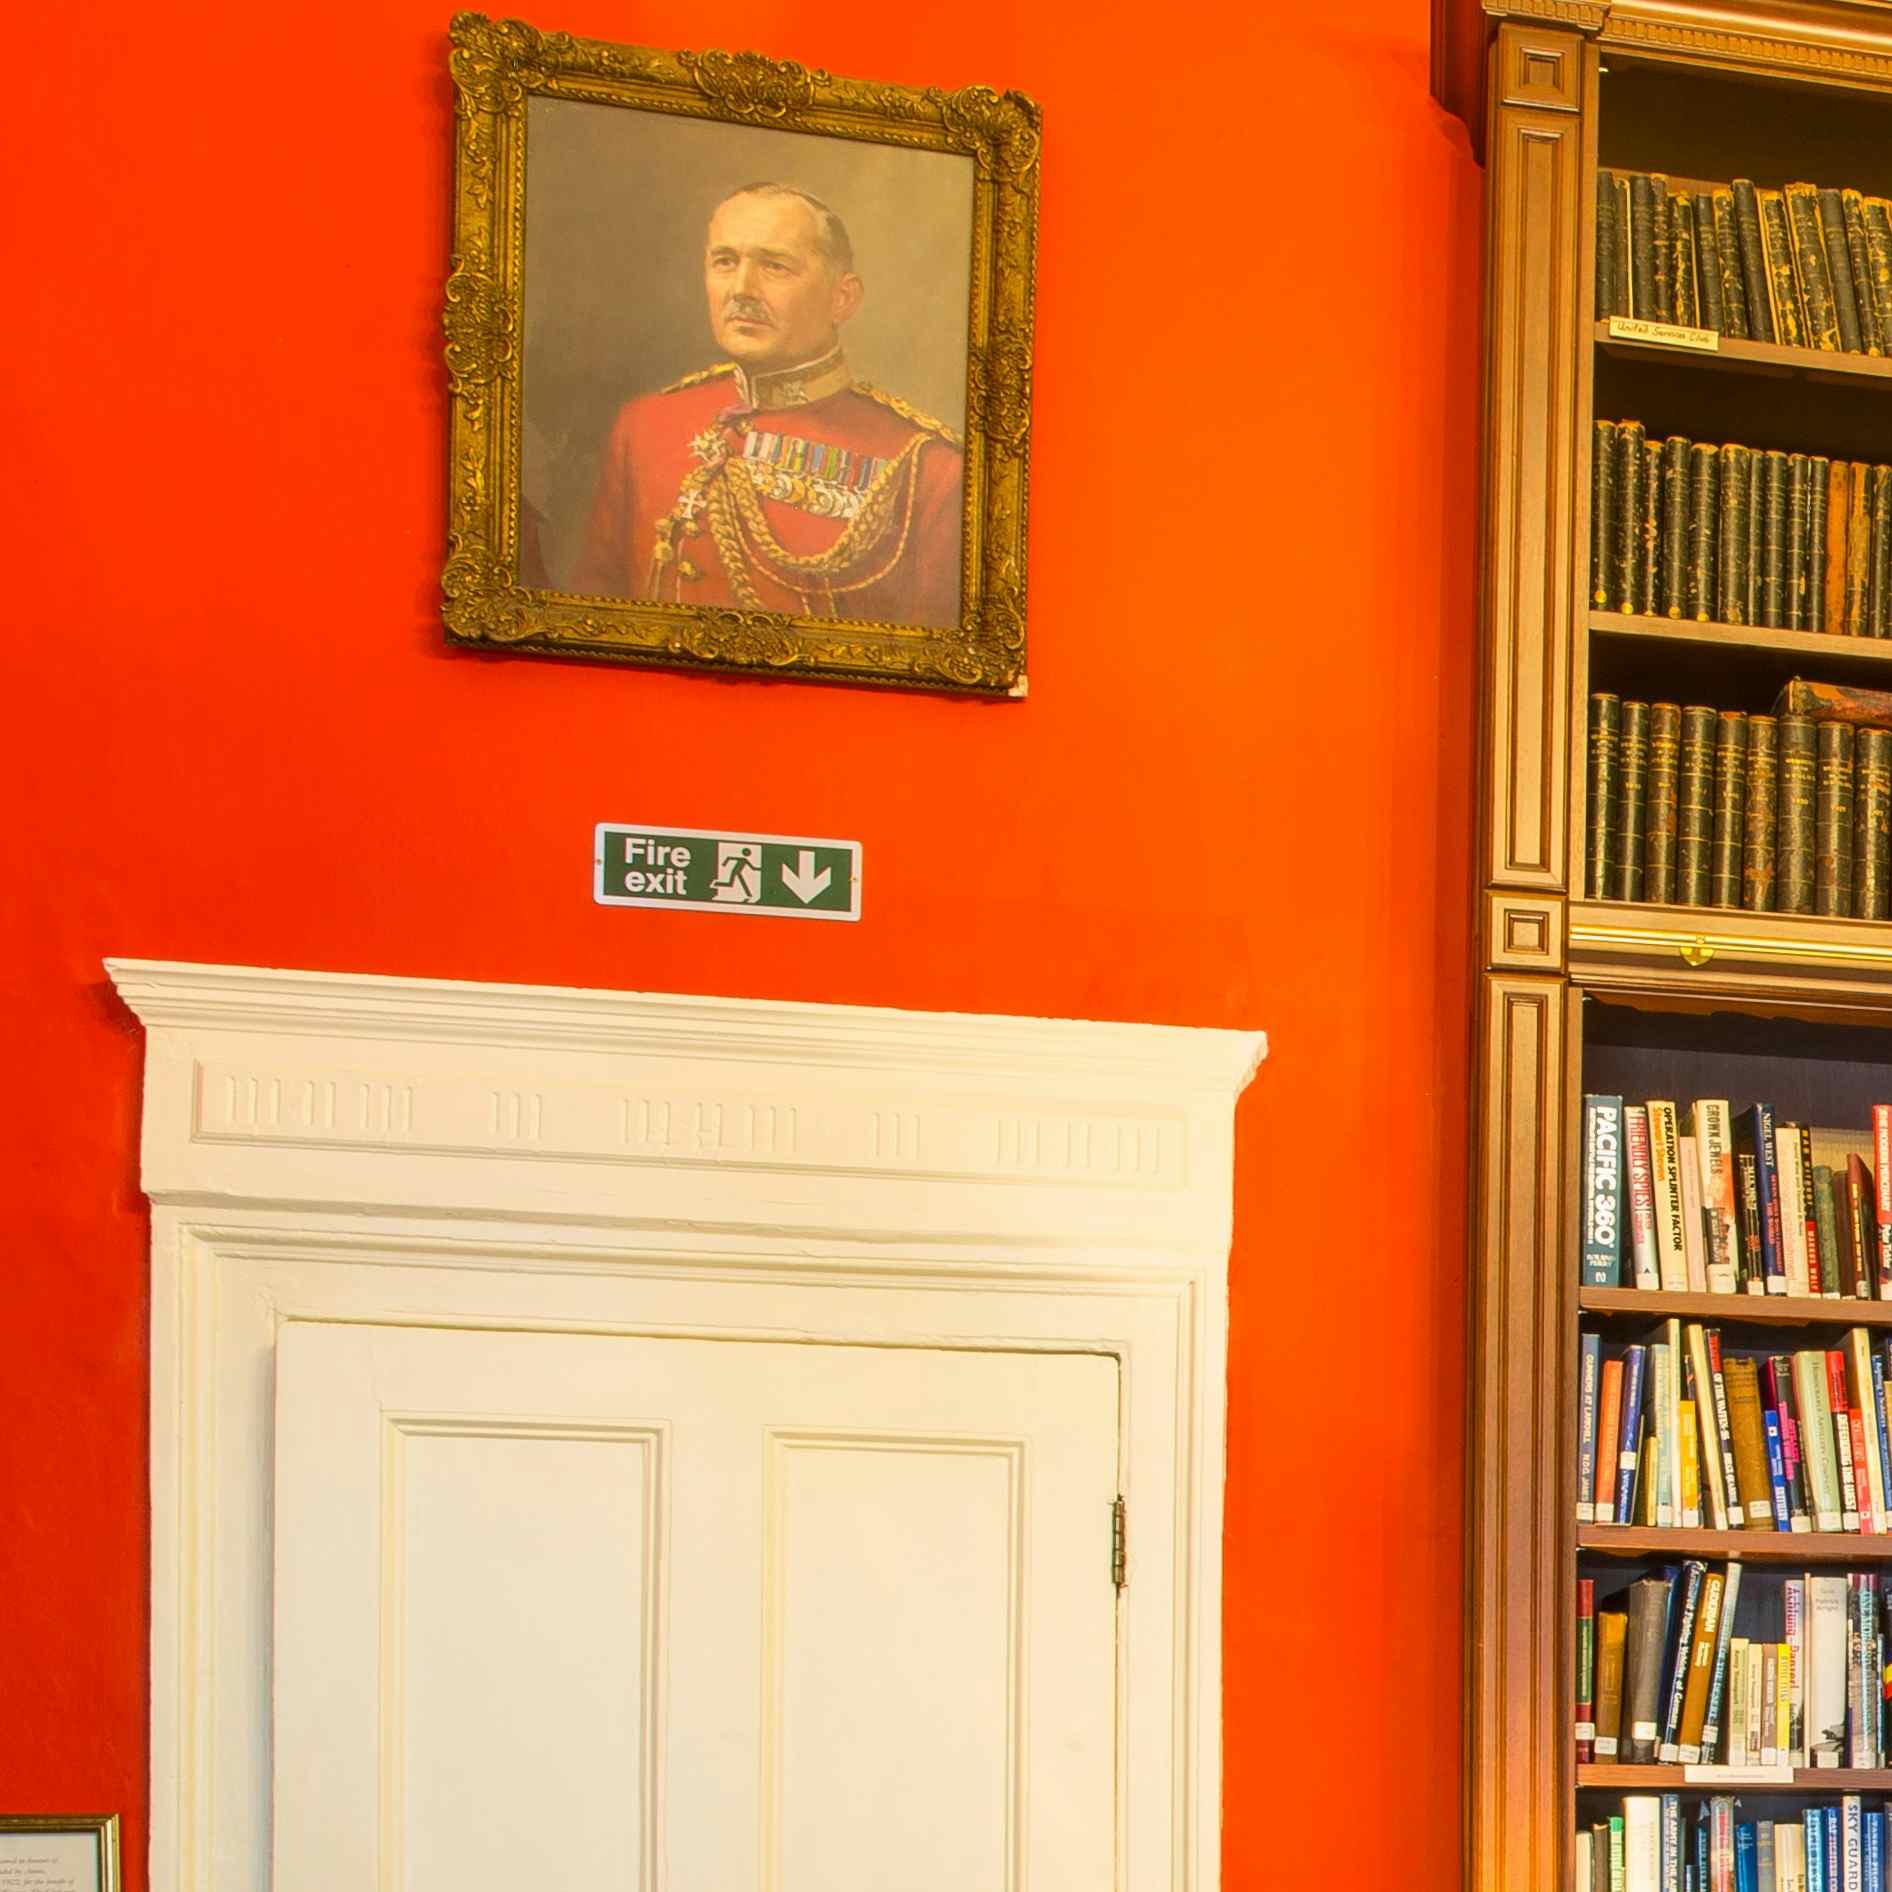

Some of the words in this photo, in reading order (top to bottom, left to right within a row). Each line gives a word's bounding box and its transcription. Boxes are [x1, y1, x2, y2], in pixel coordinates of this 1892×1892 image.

[624, 837, 691, 868] Fire
[624, 869, 687, 895] exit
[1596, 1107, 1618, 1191] PACIFIC
[1663, 1107, 1675, 1164] OPERATION
[1667, 1166, 1678, 1216] SPLINTER
[1671, 1216, 1682, 1252] FACTOR
[1846, 1802, 1860, 1834] SKY
